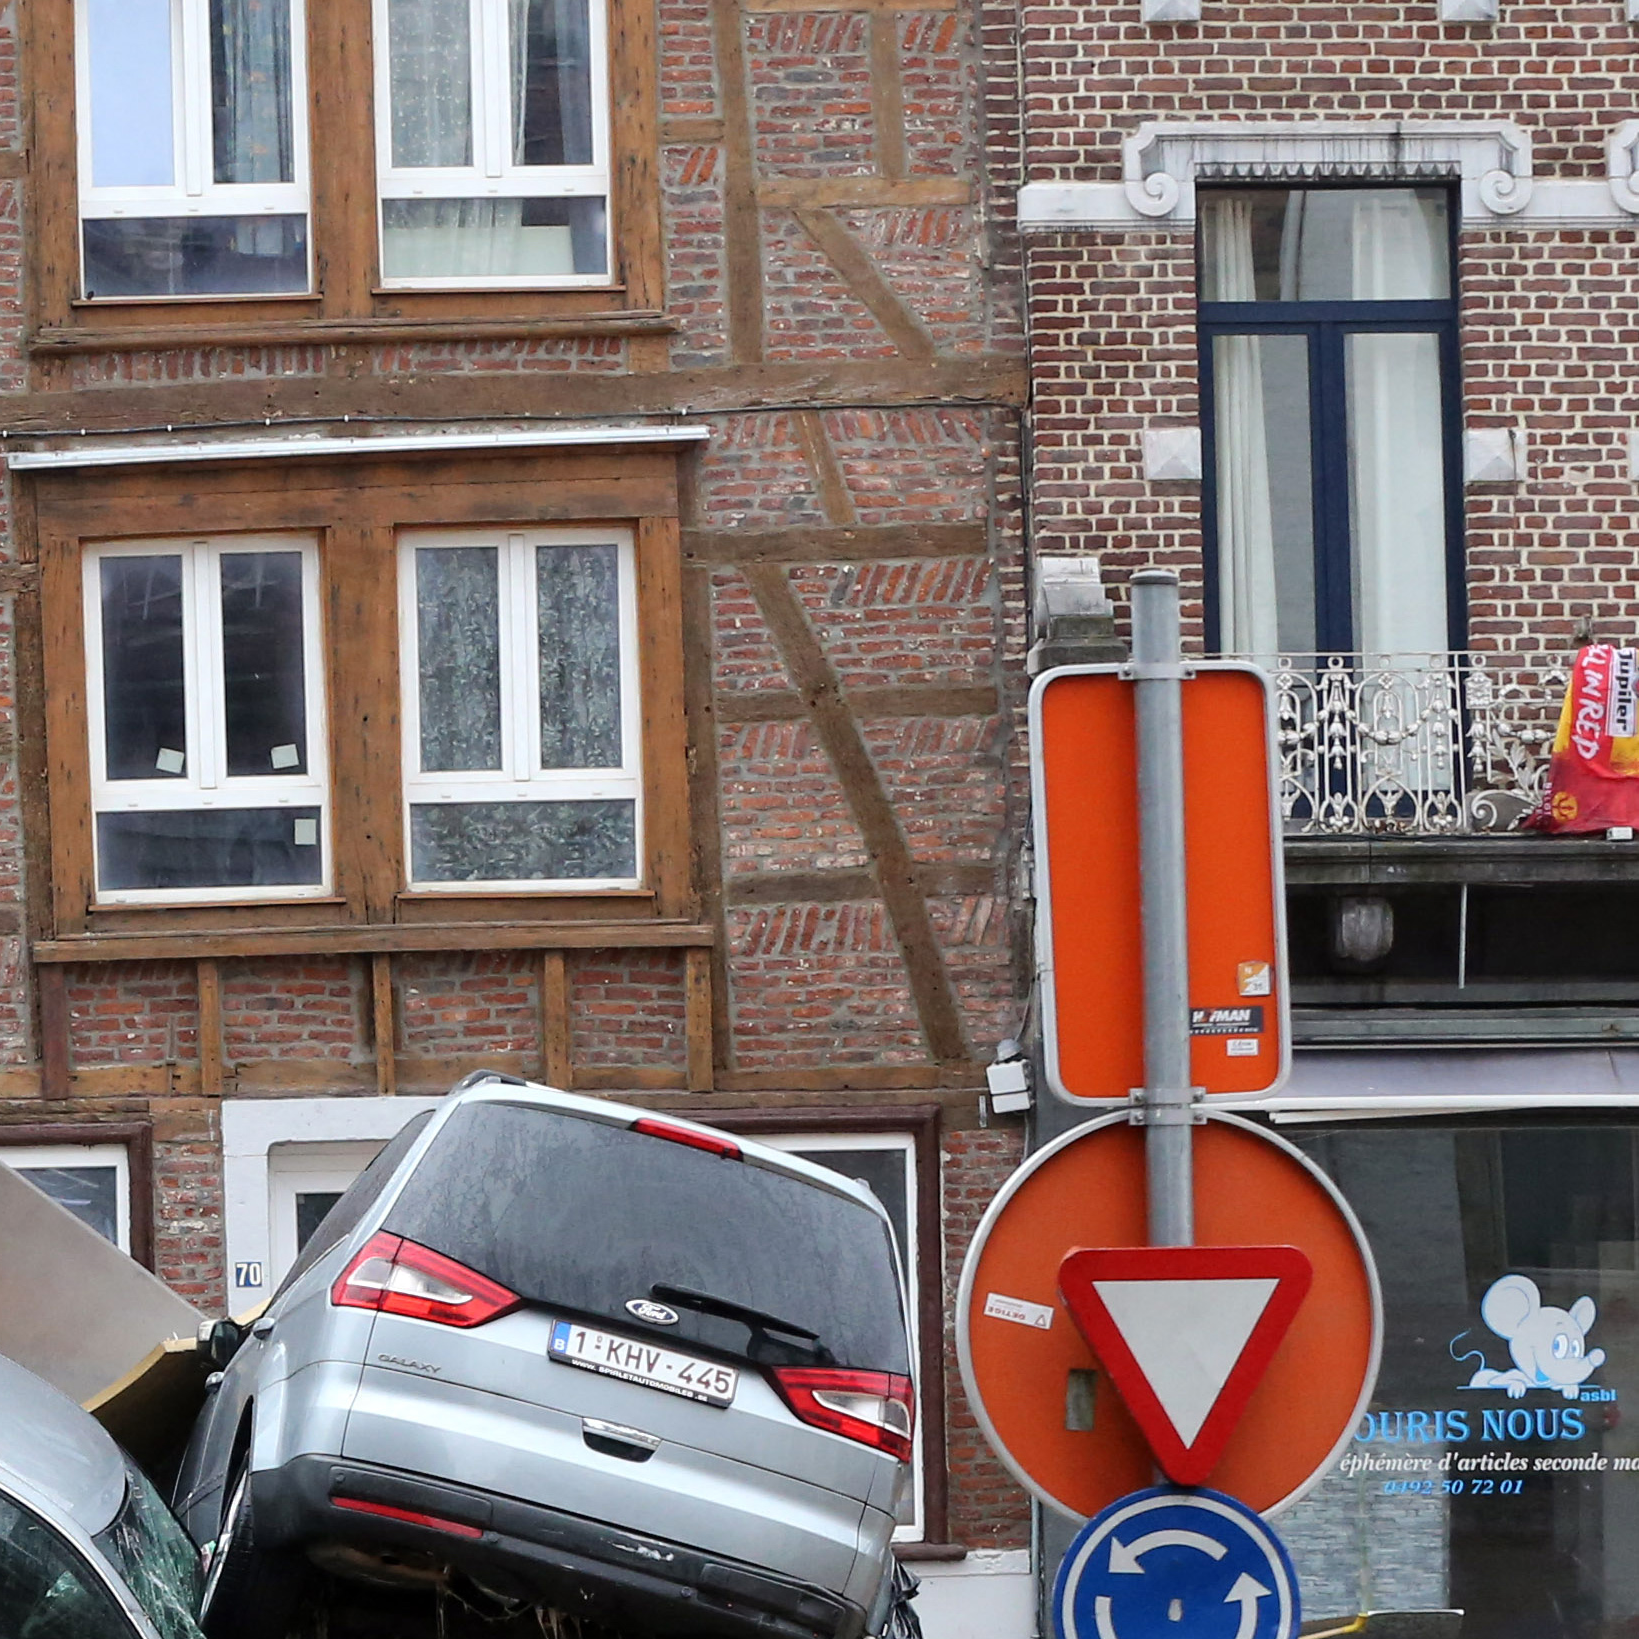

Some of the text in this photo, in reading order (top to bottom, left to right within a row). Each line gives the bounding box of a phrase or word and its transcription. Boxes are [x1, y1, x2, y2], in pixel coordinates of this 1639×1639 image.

[1615, 650, 1633, 732] Jupiler
[236, 1263, 261, 1286] 70
[633, 1302, 671, 1321] Ford
[553, 1338, 566, 1351] B
[1580, 1388, 1617, 1402] asbl
[1481, 1408, 1587, 1443] NOUS
[1339, 1452, 1433, 1478] éphémère
[1438, 1452, 1528, 1472] d'articles
[1532, 1452, 1608, 1472] seconde
[1440, 1479, 1464, 1495] 50
[1471, 1479, 1494, 1495] 72
[1499, 1479, 1524, 1495] 01
